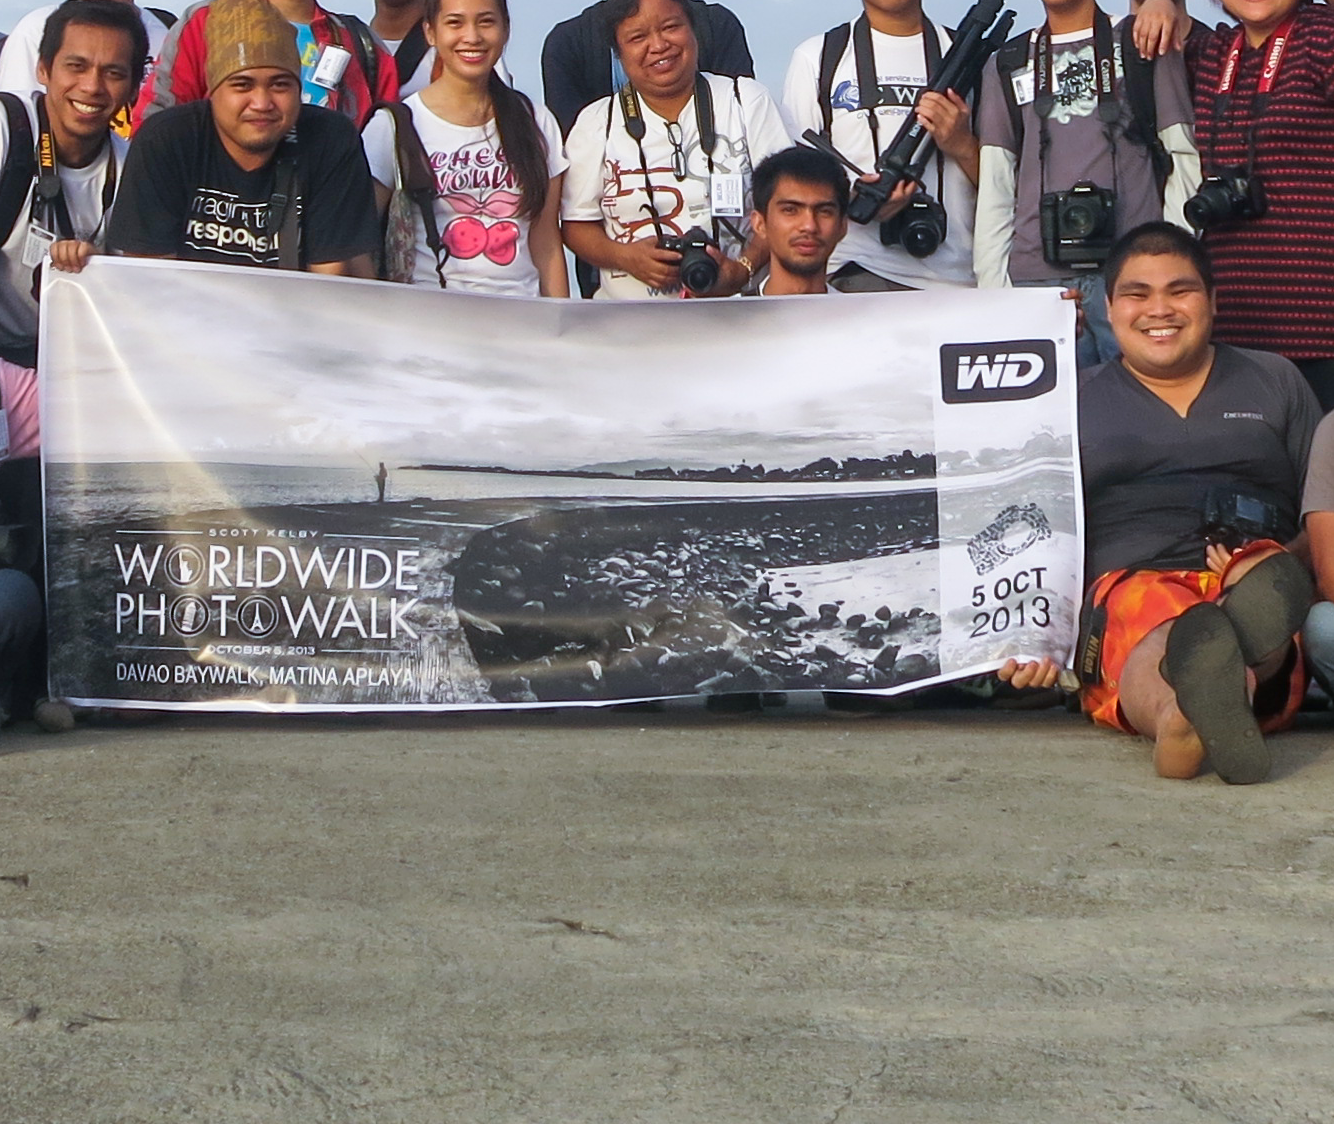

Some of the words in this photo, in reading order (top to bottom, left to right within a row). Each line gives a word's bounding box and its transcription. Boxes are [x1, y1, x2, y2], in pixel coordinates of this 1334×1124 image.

[1100, 59, 1111, 93] Canon
[1263, 37, 1285, 78] Canon
[40, 133, 53, 167] Nikon
[956, 352, 1045, 391] WD
[208, 528, 259, 537] SCOTT
[266, 529, 318, 538] KELBY
[114, 543, 420, 591] WORLDWIDE
[971, 584, 986, 608] 5
[993, 567, 1047, 601] OCT
[116, 592, 419, 640] PHOTOWALK
[969, 595, 1051, 639] 2013
[207, 644, 271, 656] OCTOBER
[287, 646, 316, 656] 2013
[1083, 634, 1099, 674] Nikon
[116, 663, 170, 683] DAVAO
[174, 664, 265, 686] BAYWALK,
[269, 665, 339, 686] MATINA
[343, 666, 414, 687] APLAYA
